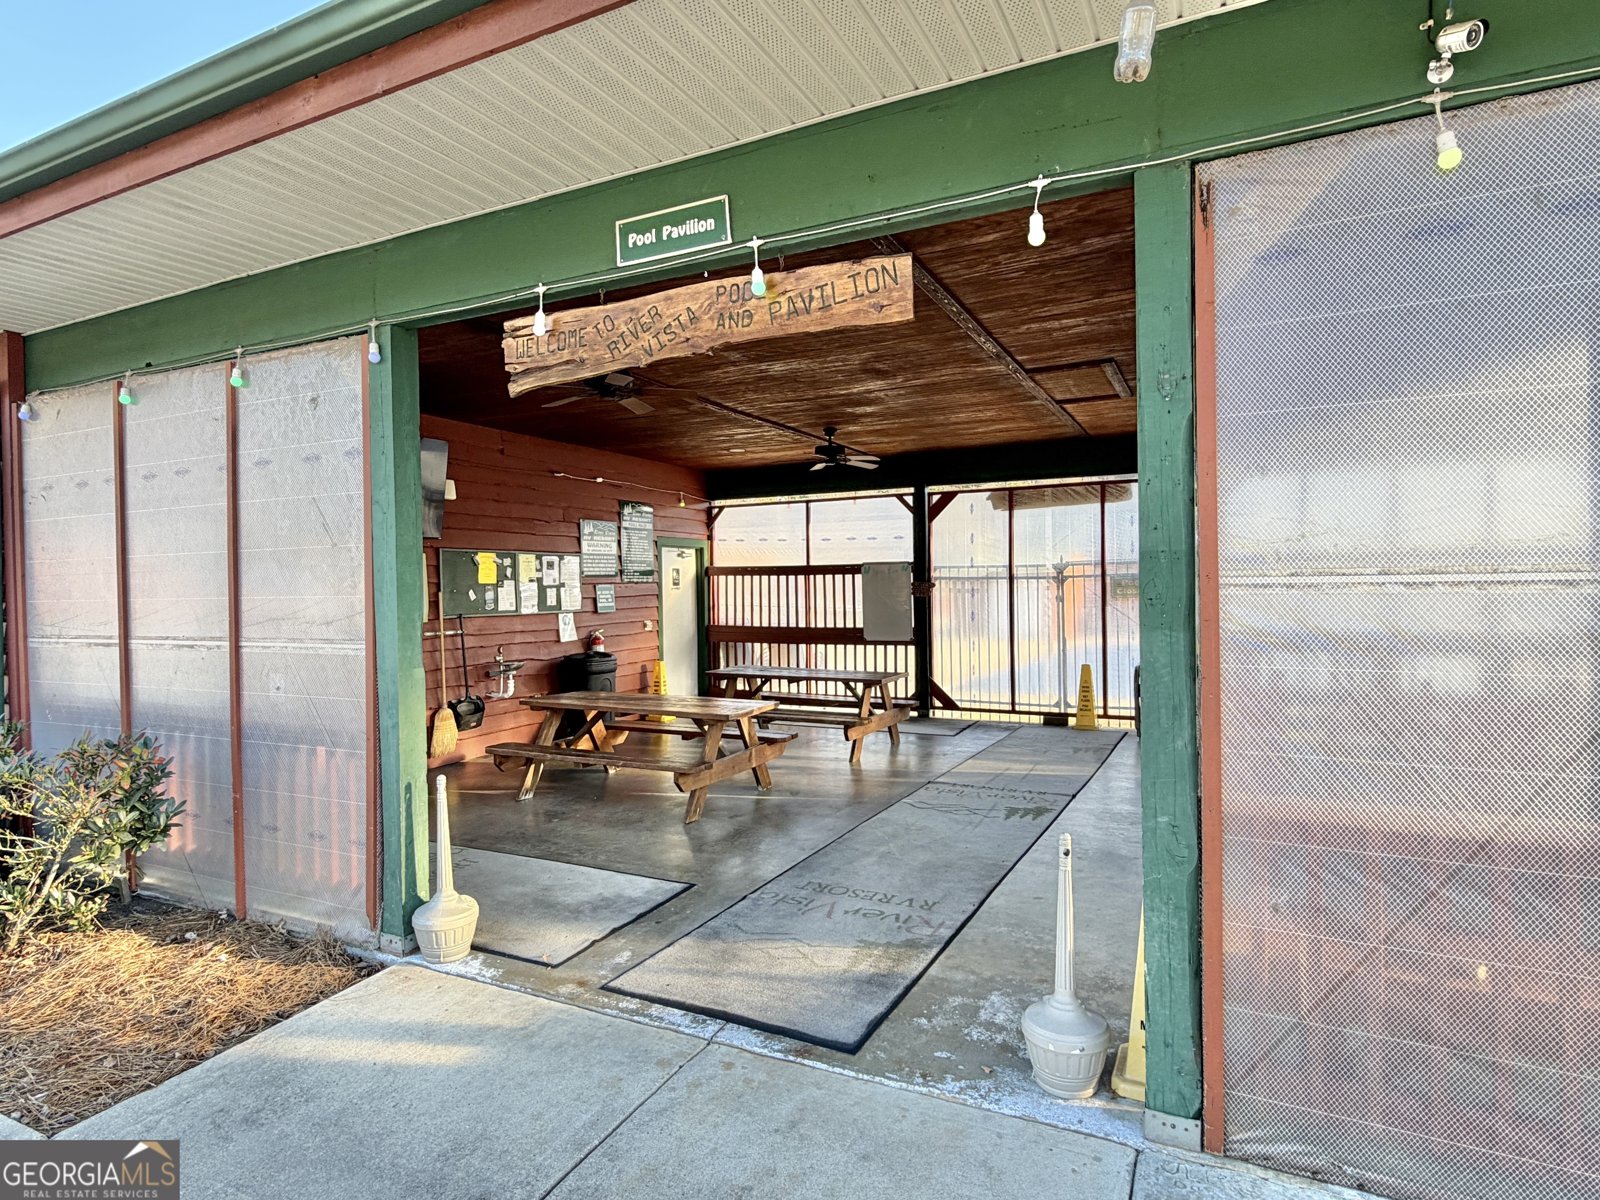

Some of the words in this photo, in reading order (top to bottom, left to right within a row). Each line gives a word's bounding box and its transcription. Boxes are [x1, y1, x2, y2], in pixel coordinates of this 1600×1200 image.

[628, 228, 657, 248] Pool
[662, 218, 716, 241] Pavilion
[715, 309, 754, 331] AND
[768, 260, 900, 326] PAVILION
[515, 326, 589, 360] WELCOME
[591, 313, 616, 340] TO
[606, 304, 664, 359] RIVER
[640, 306, 700, 359] VISTA
[759, 890, 837, 920] Vista
[796, 880, 897, 905] RESORT
[842, 906, 947, 938] River
